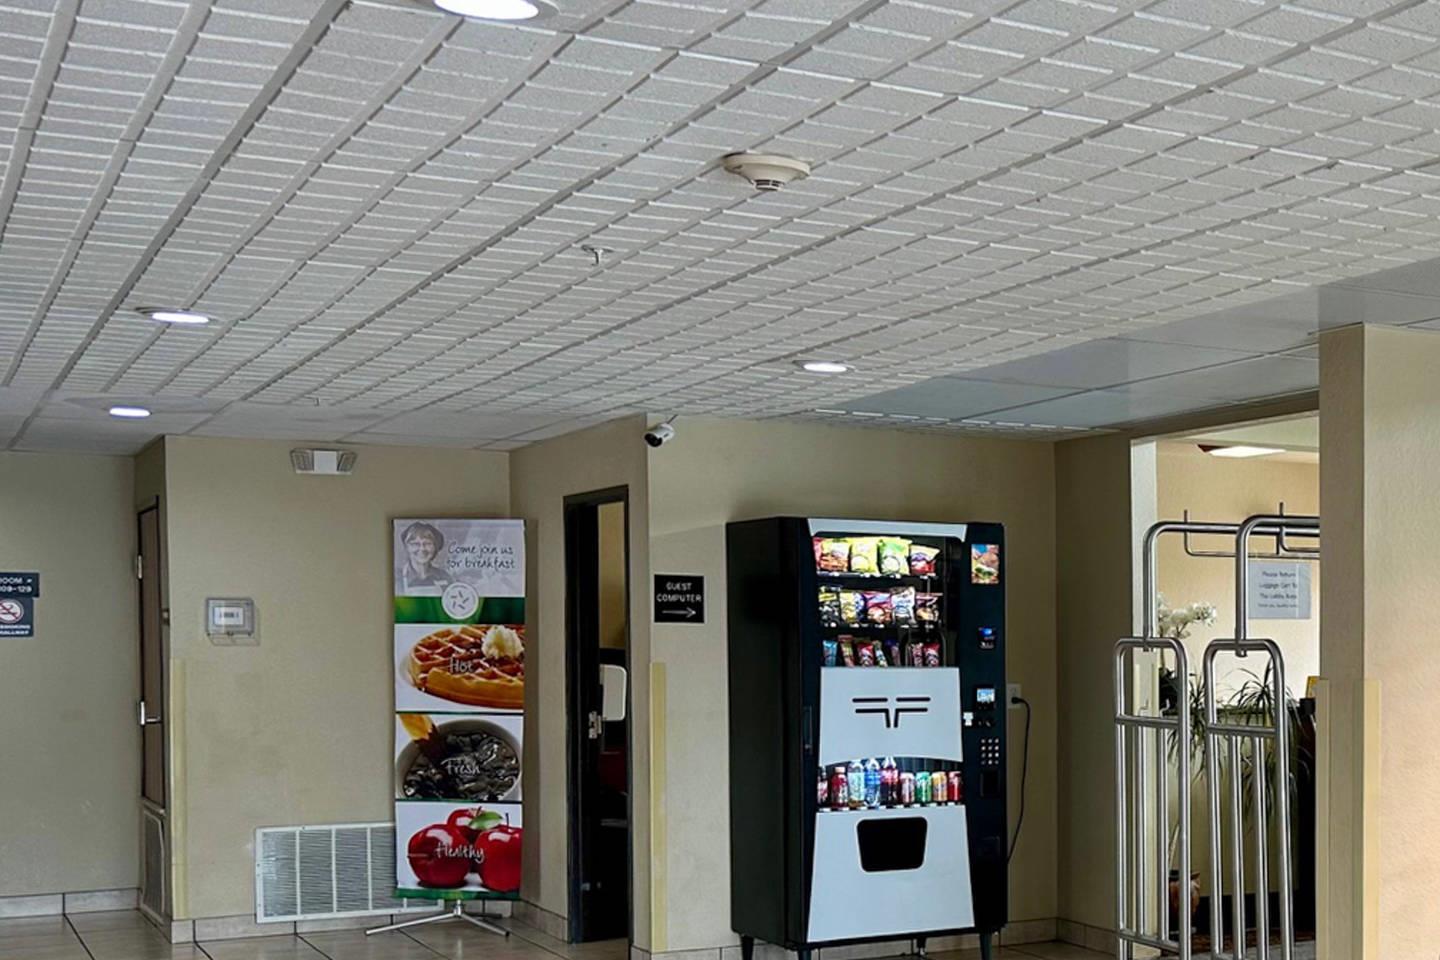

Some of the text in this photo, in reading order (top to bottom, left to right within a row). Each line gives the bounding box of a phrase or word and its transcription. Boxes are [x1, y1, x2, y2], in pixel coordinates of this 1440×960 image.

[447, 541, 514, 559] Come join us
[447, 556, 515, 573] for breakfast
[665, 581, 692, 591] GUEST
[656, 593, 702, 603] COMPUTER
[449, 654, 475, 674] Hot
[440, 757, 481, 776] Fresh
[433, 841, 485, 864] Healthy
